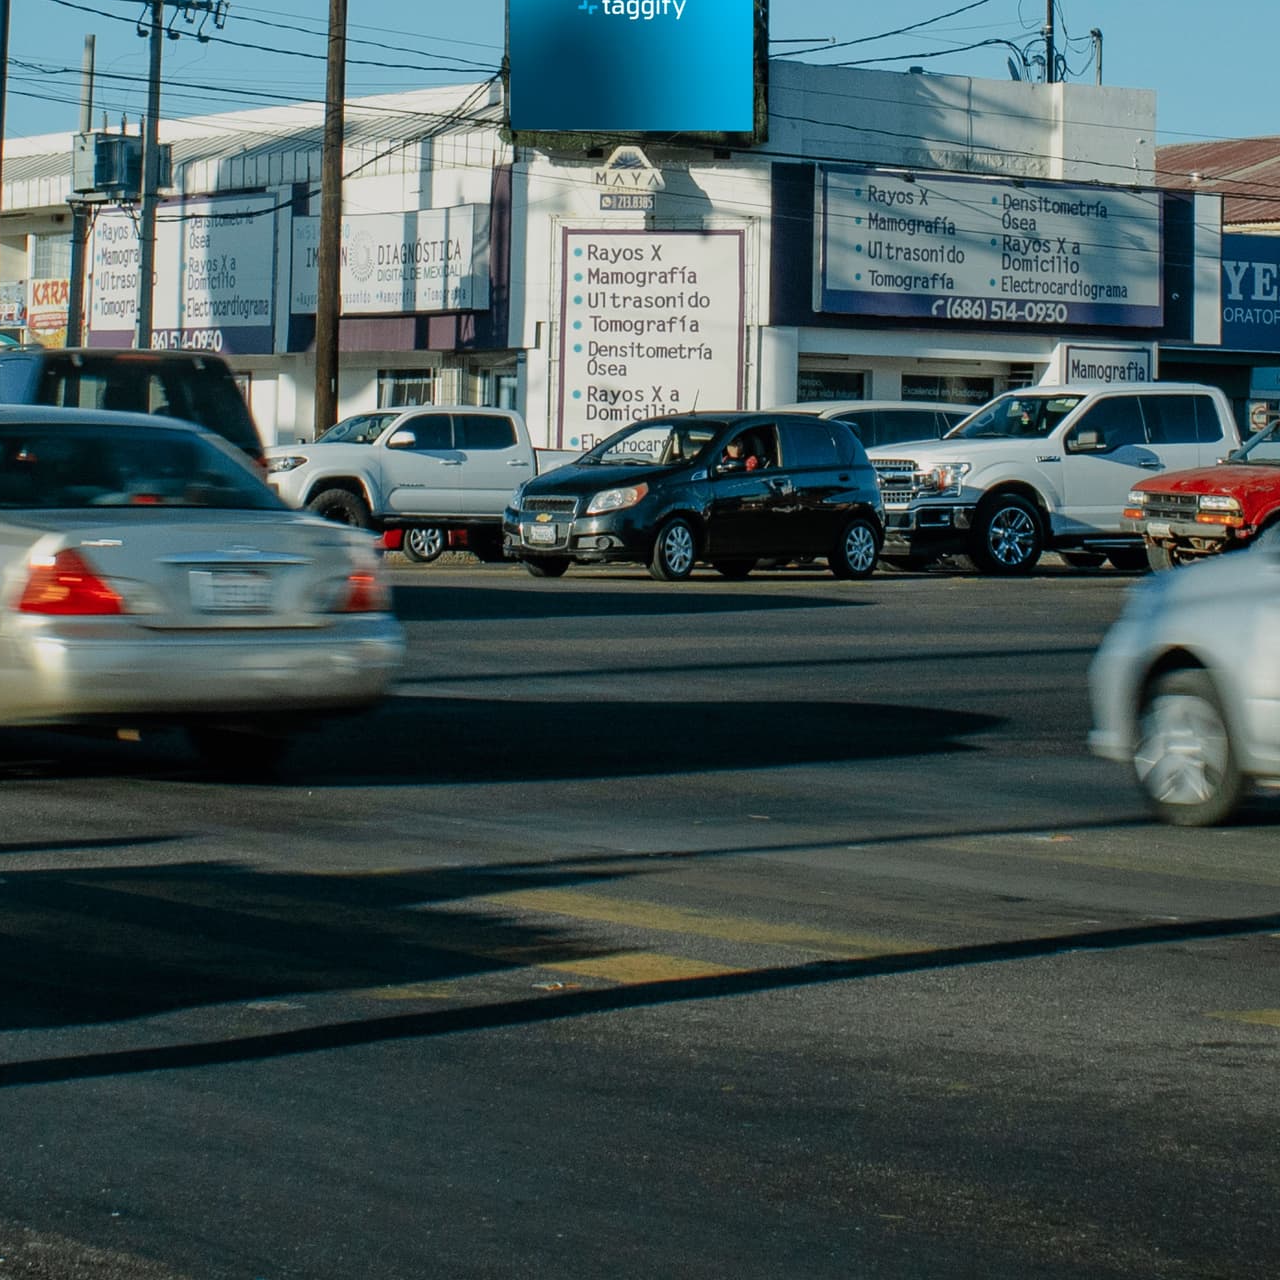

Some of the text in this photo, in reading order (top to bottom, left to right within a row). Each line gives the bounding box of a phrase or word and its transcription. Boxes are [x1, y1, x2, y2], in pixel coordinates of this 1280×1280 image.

[595, 172, 660, 186] MAYA
[868, 185, 929, 207] Rayos X
[1002, 193, 1108, 219] Densitometría
[868, 212, 956, 237] Mamografía
[1002, 210, 1037, 232] Ósea
[102, 222, 128, 244] Rayos
[189, 229, 211, 250] Ósea
[377, 238, 462, 266] DIAGNÓSTICA
[587, 244, 662, 264] Rayos X
[868, 240, 965, 265] Ultrasonido
[1002, 234, 1081, 256] Rayos X a
[101, 247, 139, 268] Mamogra
[188, 255, 236, 276] Rayos X a
[1002, 253, 1080, 275] Domicilio
[187, 271, 236, 291] Domicilio
[376, 264, 463, 282] DIGITAL DE MEXICALI
[587, 266, 697, 288] Mamografía
[868, 270, 955, 292] Tomografía
[1001, 275, 1128, 299] Electrocardiograma
[100, 296, 135, 319] Tomogra
[187, 295, 269, 320] Electrocardiograma
[587, 291, 710, 309] Ultrasonido
[946, 298, 1068, 323] (686) 514-0930
[589, 315, 700, 336] Tomografía
[588, 341, 713, 360] Densitometría
[587, 357, 627, 377] Ósea
[587, 386, 680, 406] Rayos X a
